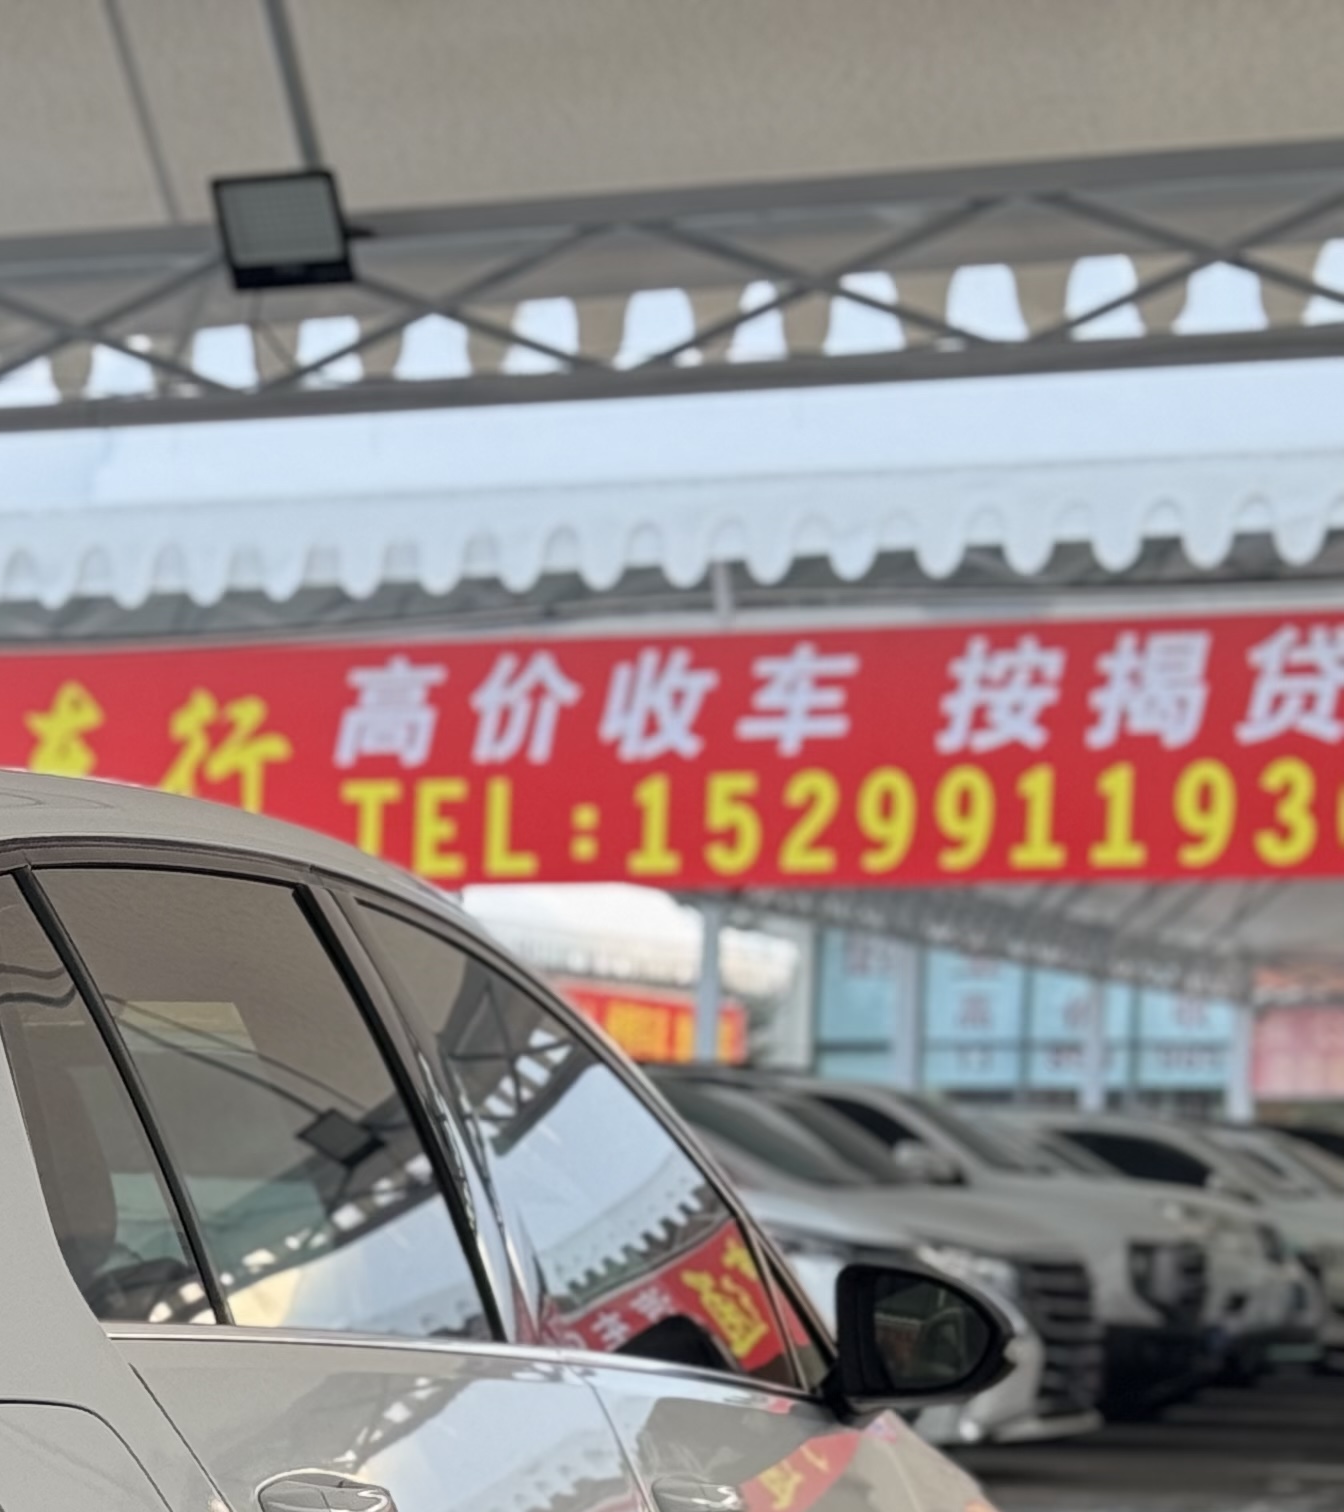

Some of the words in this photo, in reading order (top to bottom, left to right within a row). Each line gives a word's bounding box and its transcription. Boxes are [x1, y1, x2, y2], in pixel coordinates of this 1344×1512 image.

[333, 643, 860, 767] 高价收车
[935, 622, 1344, 753] 按揭贷
[341, 754, 1344, 878] TEL:152991193
